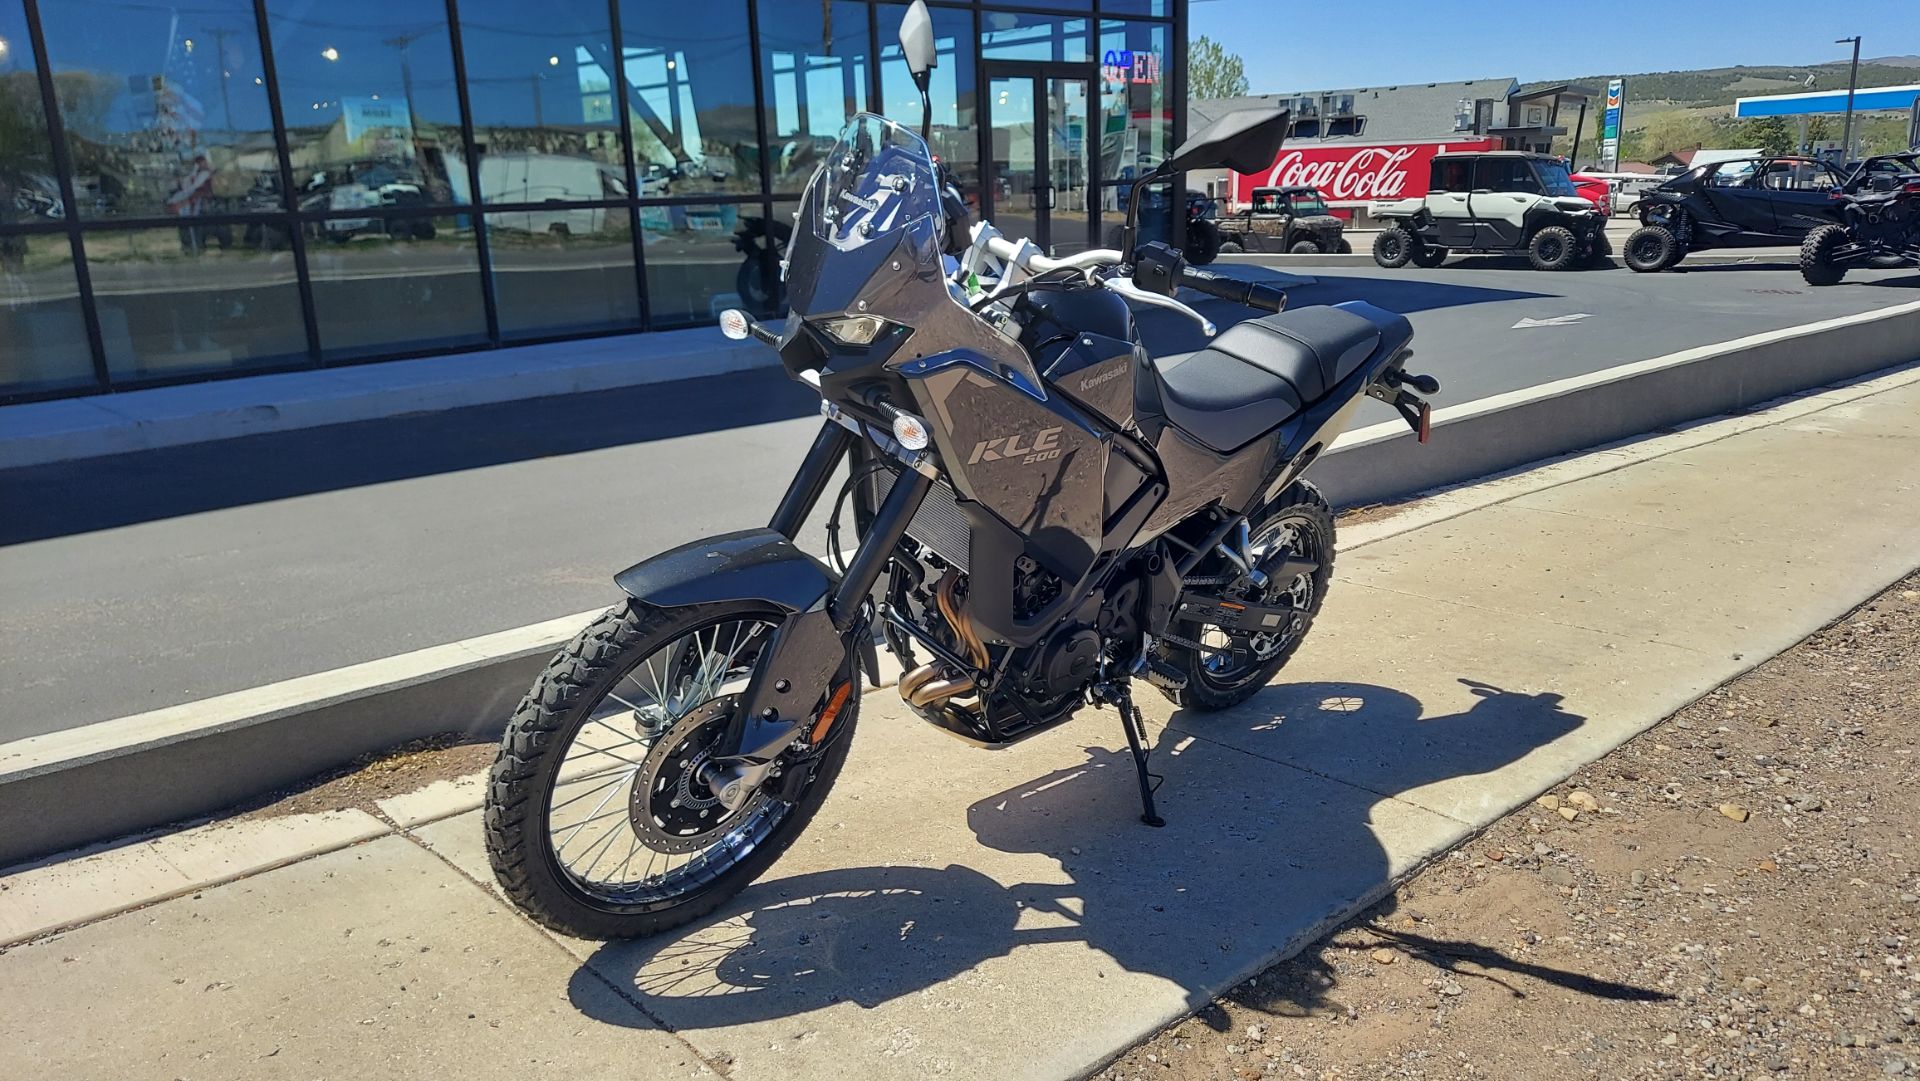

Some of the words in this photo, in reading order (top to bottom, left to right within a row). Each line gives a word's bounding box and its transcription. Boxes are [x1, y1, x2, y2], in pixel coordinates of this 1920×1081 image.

[1104, 50, 1160, 83] OPEN
[1267, 147, 1418, 198] Coca-Cola
[840, 188, 877, 212] Kawasaki
[1080, 361, 1128, 392] Kawasaki
[967, 425, 1063, 465] KLE
[1022, 448, 1062, 465] 500
